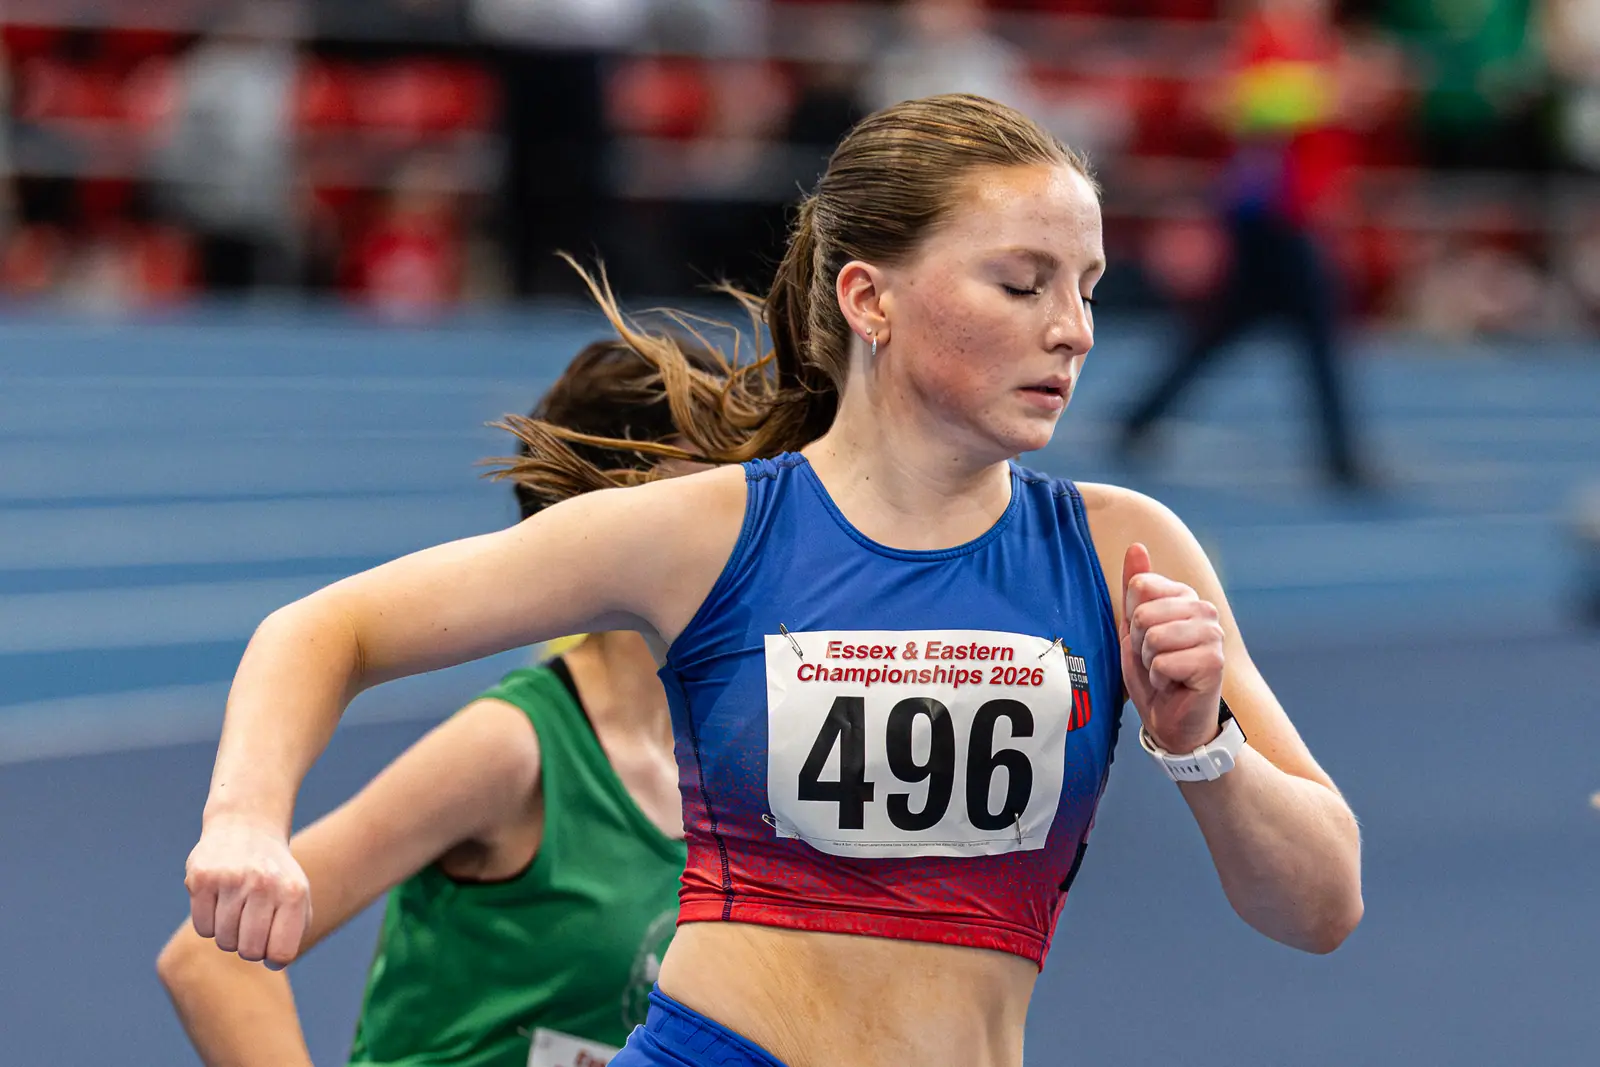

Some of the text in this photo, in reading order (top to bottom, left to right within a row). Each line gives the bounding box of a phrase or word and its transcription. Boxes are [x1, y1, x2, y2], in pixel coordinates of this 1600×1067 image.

[826, 641, 1014, 661] Essex & Eastern
[797, 663, 1044, 688] Championships 2026
[797, 696, 1035, 831] 496
